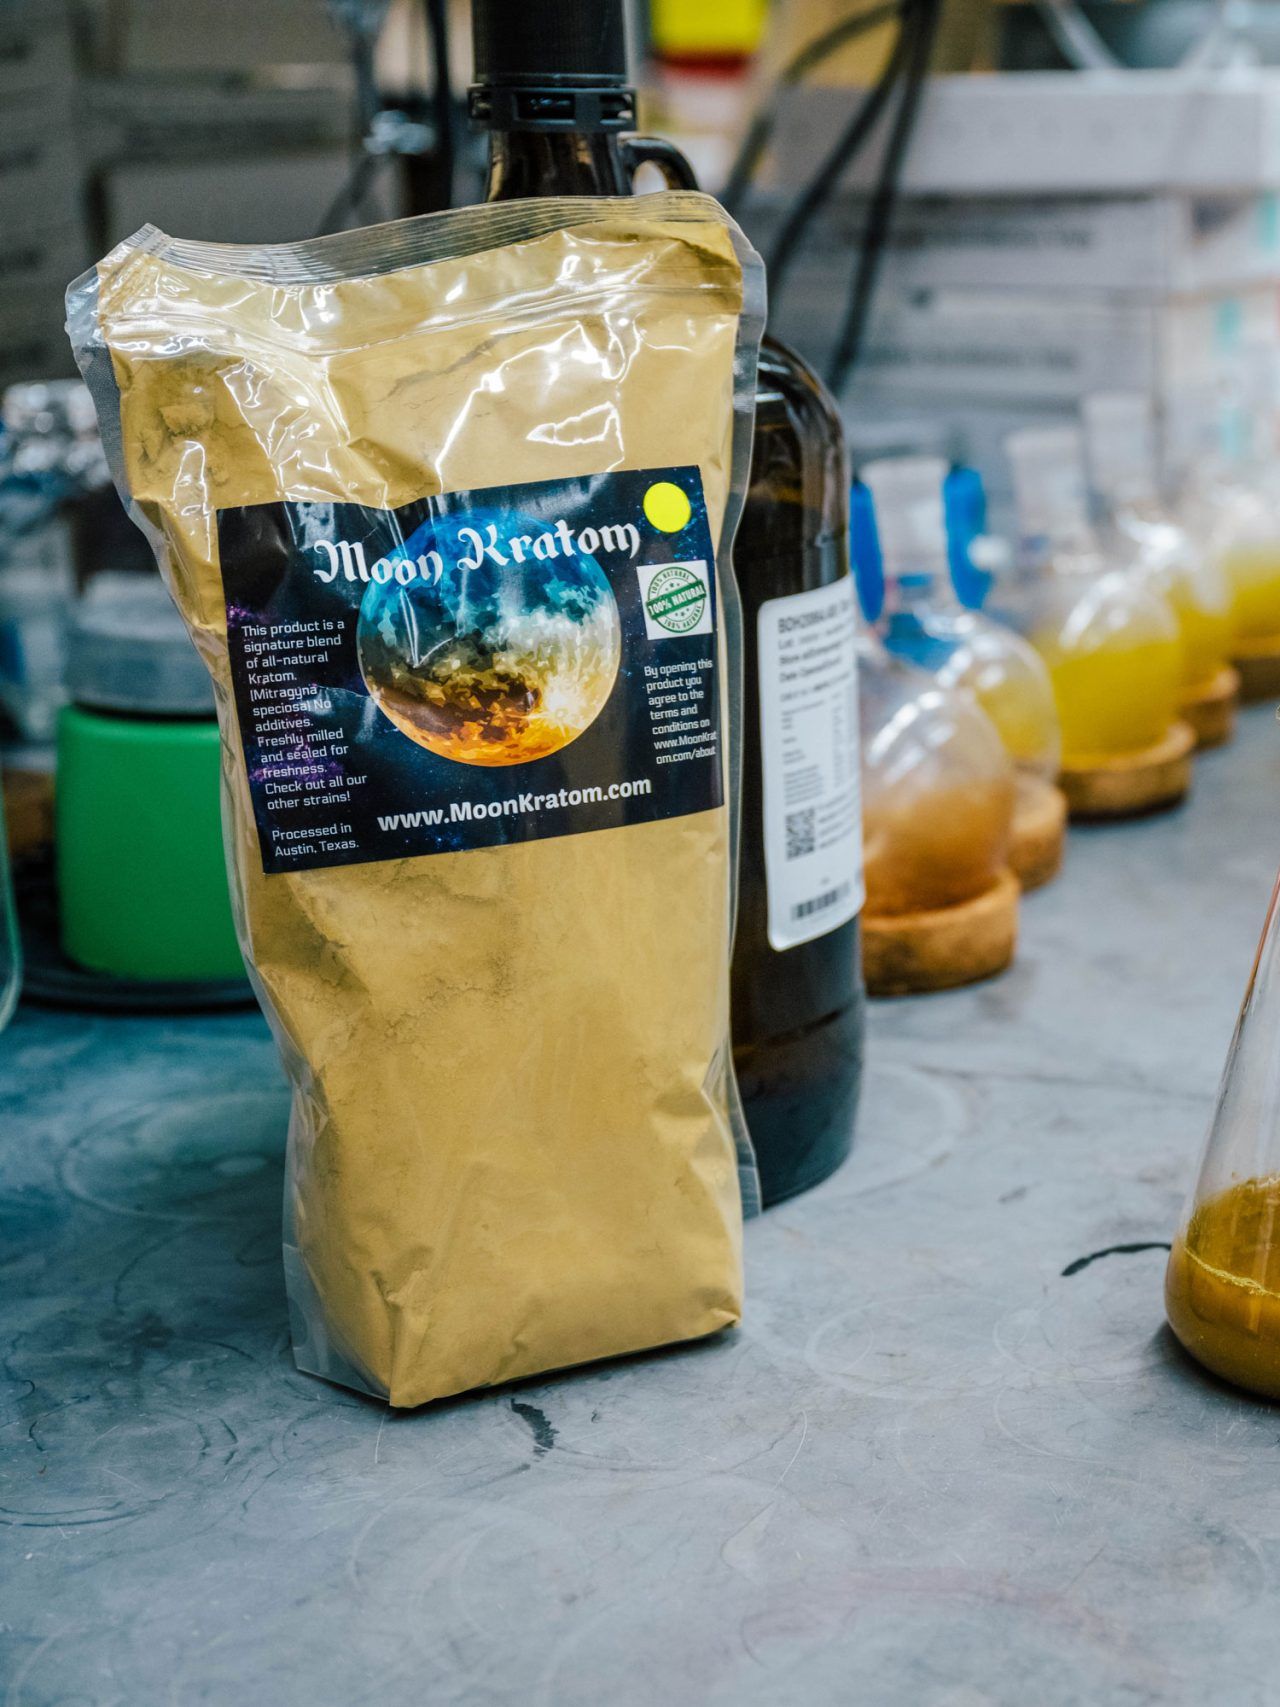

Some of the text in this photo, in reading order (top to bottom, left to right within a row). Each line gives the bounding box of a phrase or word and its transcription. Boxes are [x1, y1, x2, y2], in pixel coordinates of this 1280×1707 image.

[313, 519, 641, 586] Moon Kratom
[648, 584, 705, 616] 100% NATURAL
[241, 619, 345, 638] This product is a
[243, 634, 342, 655] signature blend
[246, 651, 329, 669] of all-natural
[644, 658, 713, 679] By opening this
[248, 672, 297, 685] Kratom.
[646, 676, 703, 694] product you
[313, 699, 332, 710] No
[648, 689, 704, 708] agree to the
[650, 703, 698, 720] terms and
[255, 718, 314, 733] additives.
[652, 718, 711, 735] conditions on
[257, 727, 344, 748] Freshly milled
[260, 744, 349, 764] and sealed for
[262, 764, 328, 779] freshness.
[265, 775, 368, 795] Check out all our
[267, 790, 351, 810] other strains!
[377, 778, 652, 832] www.MoonKratom.com
[272, 823, 352, 841] Processed in
[319, 840, 360, 853] Texas.
